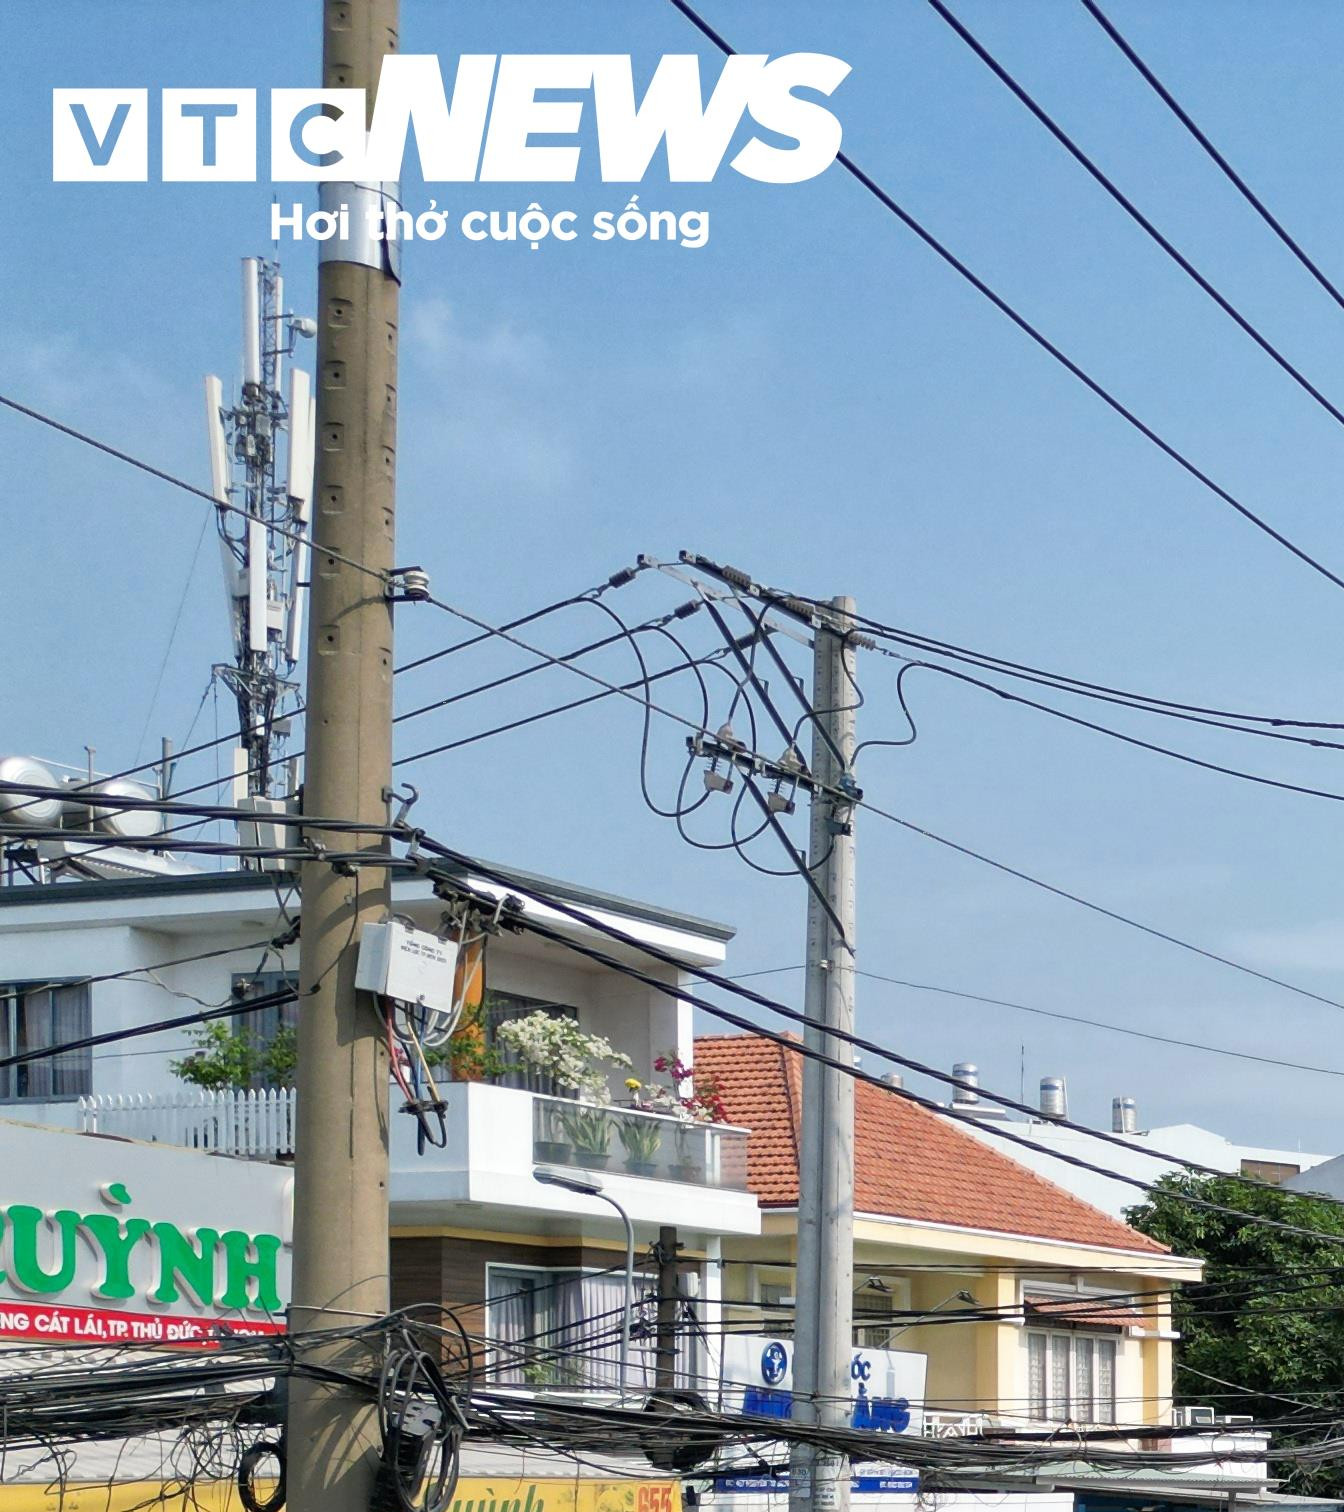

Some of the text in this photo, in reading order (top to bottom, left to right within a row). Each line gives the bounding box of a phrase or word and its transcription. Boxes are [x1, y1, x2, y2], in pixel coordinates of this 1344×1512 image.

[0, 1183, 281, 1311] UỲNH
[35, 1309, 70, 1333] CÁT
[131, 1317, 163, 1339] THỦ
